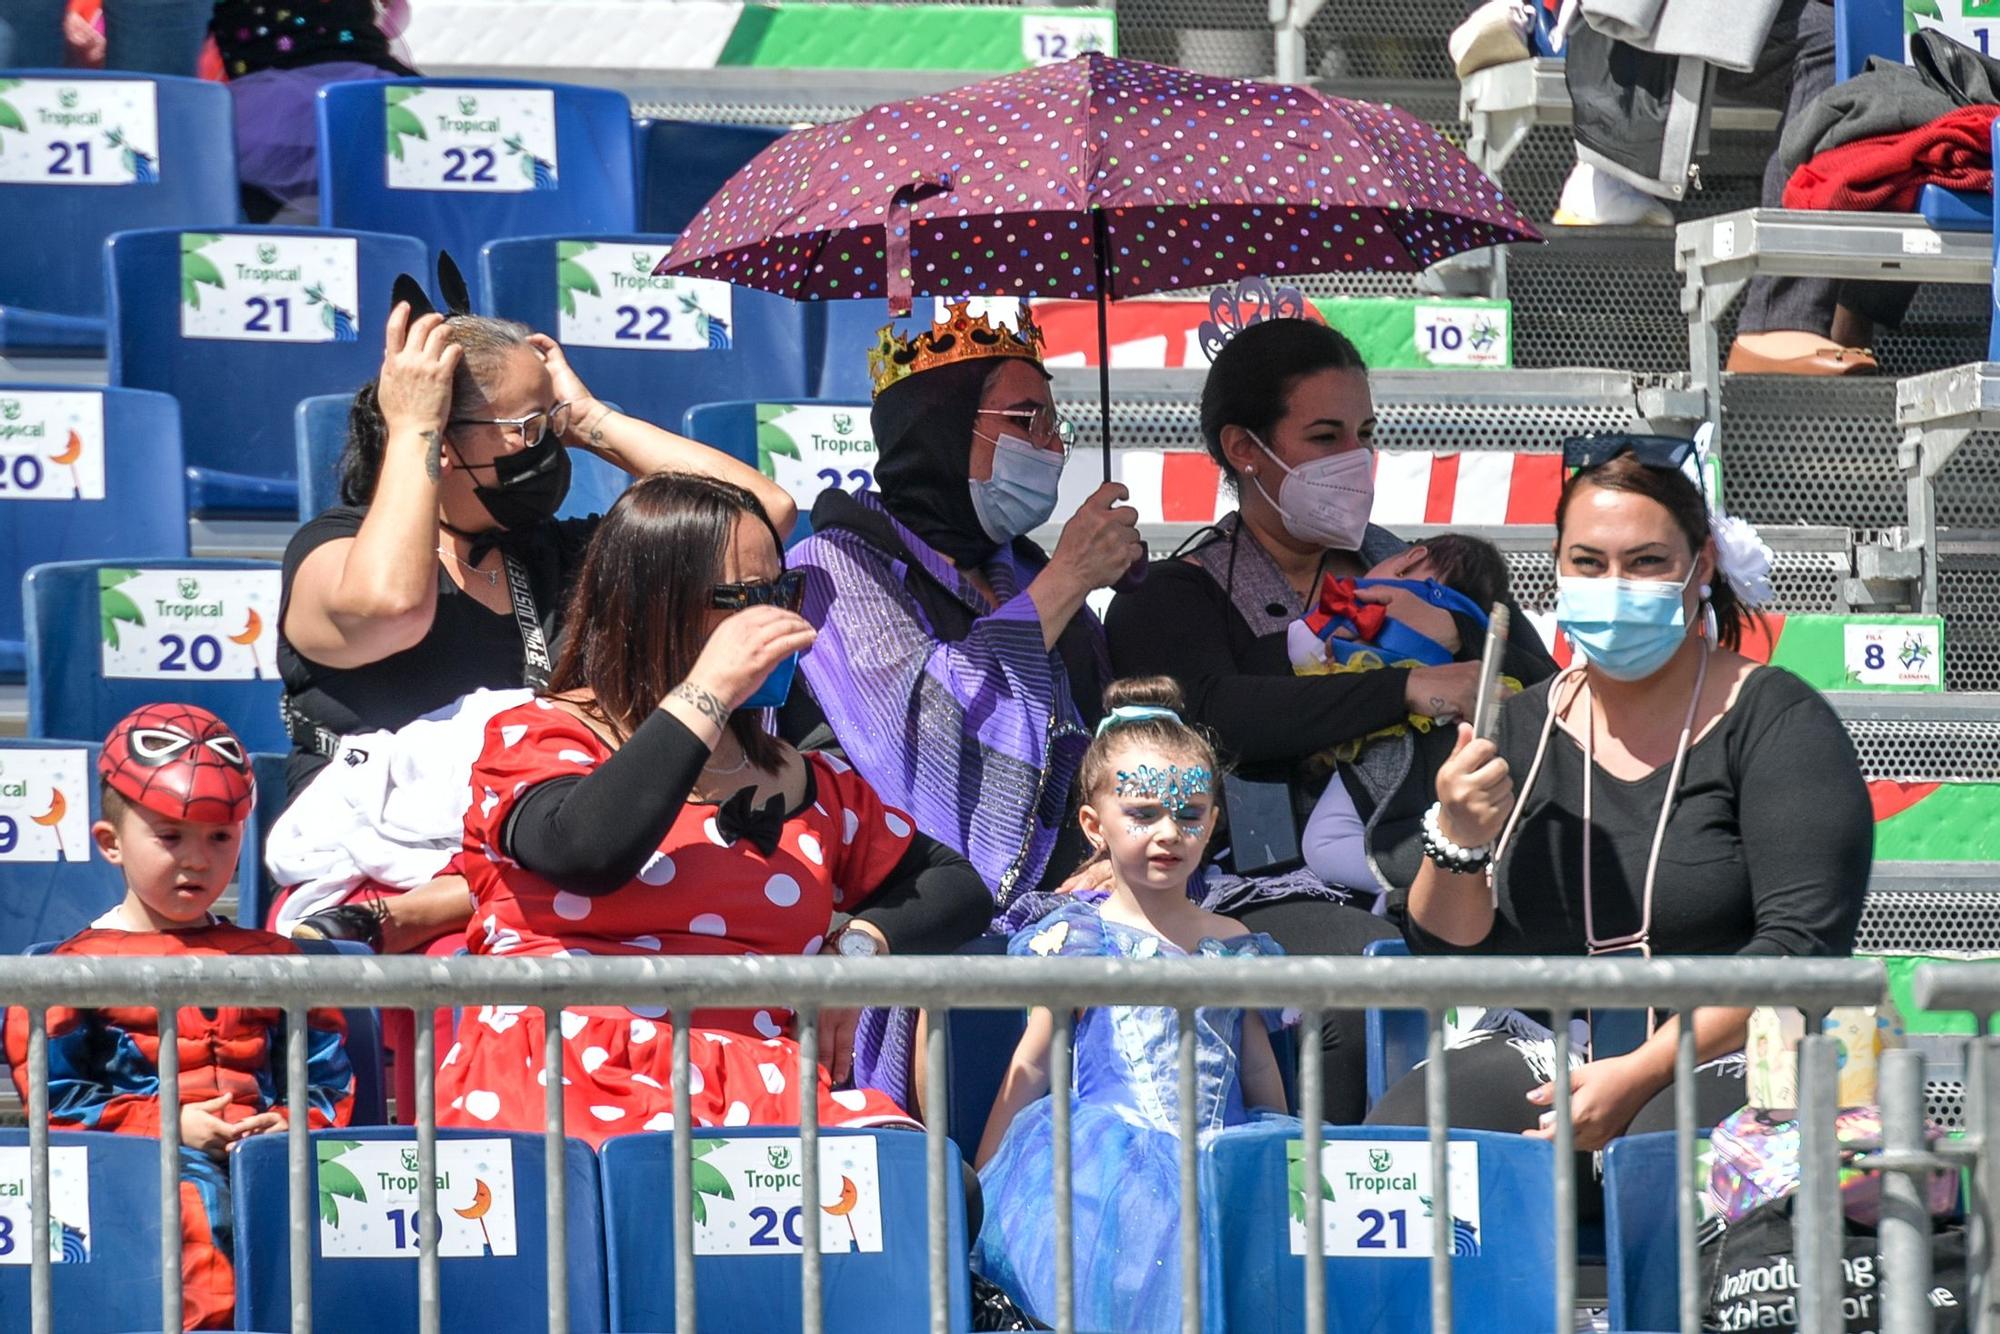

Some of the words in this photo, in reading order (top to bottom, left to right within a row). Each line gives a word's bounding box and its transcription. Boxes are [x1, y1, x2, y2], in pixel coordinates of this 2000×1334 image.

[1036, 33, 1067, 58] 12
[38, 108, 101, 127] Tropical
[438, 115, 500, 134] Tropical
[48, 140, 92, 175] 21
[442, 147, 497, 182] 22
[236, 262, 301, 284] Tropical
[611, 271, 674, 292] Tropical
[244, 295, 290, 333] 21
[615, 305, 671, 341] 22
[1425, 325, 1462, 350] 10
[811, 434, 876, 455] Tropical
[155, 599, 223, 621] Tropical
[513, 586, 538, 626] JUST
[158, 634, 222, 672] 20
[1864, 643, 1885, 670] 8
[377, 1171, 450, 1194] Tropal
[1346, 1172, 1416, 1194] Tropical
[1357, 1208, 1407, 1249] 21
